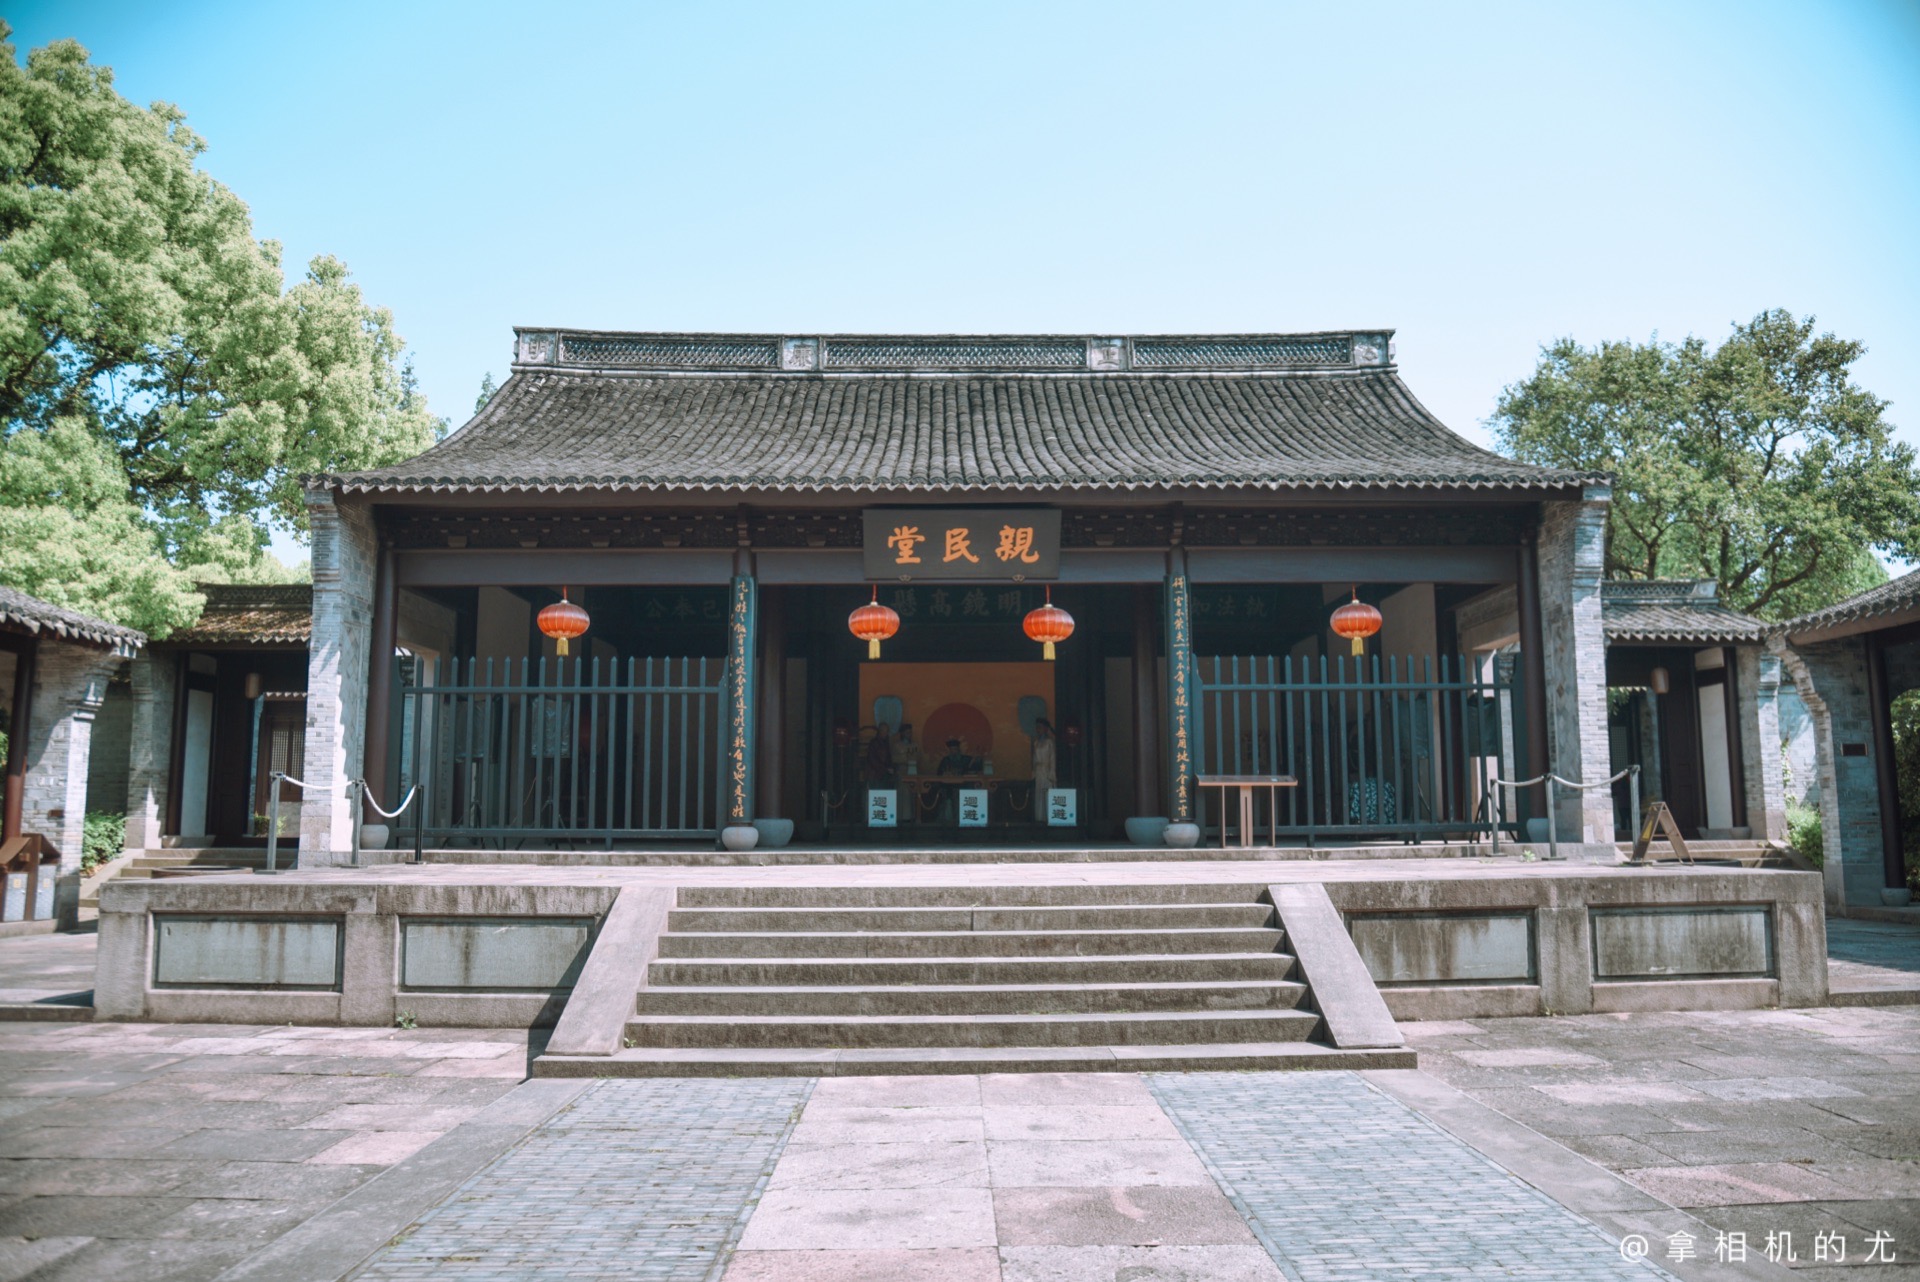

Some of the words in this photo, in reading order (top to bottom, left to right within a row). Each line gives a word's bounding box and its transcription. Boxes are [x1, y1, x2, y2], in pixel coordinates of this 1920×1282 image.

[791, 341, 814, 367] 廉
[887, 524, 1040, 564] 親民堂
